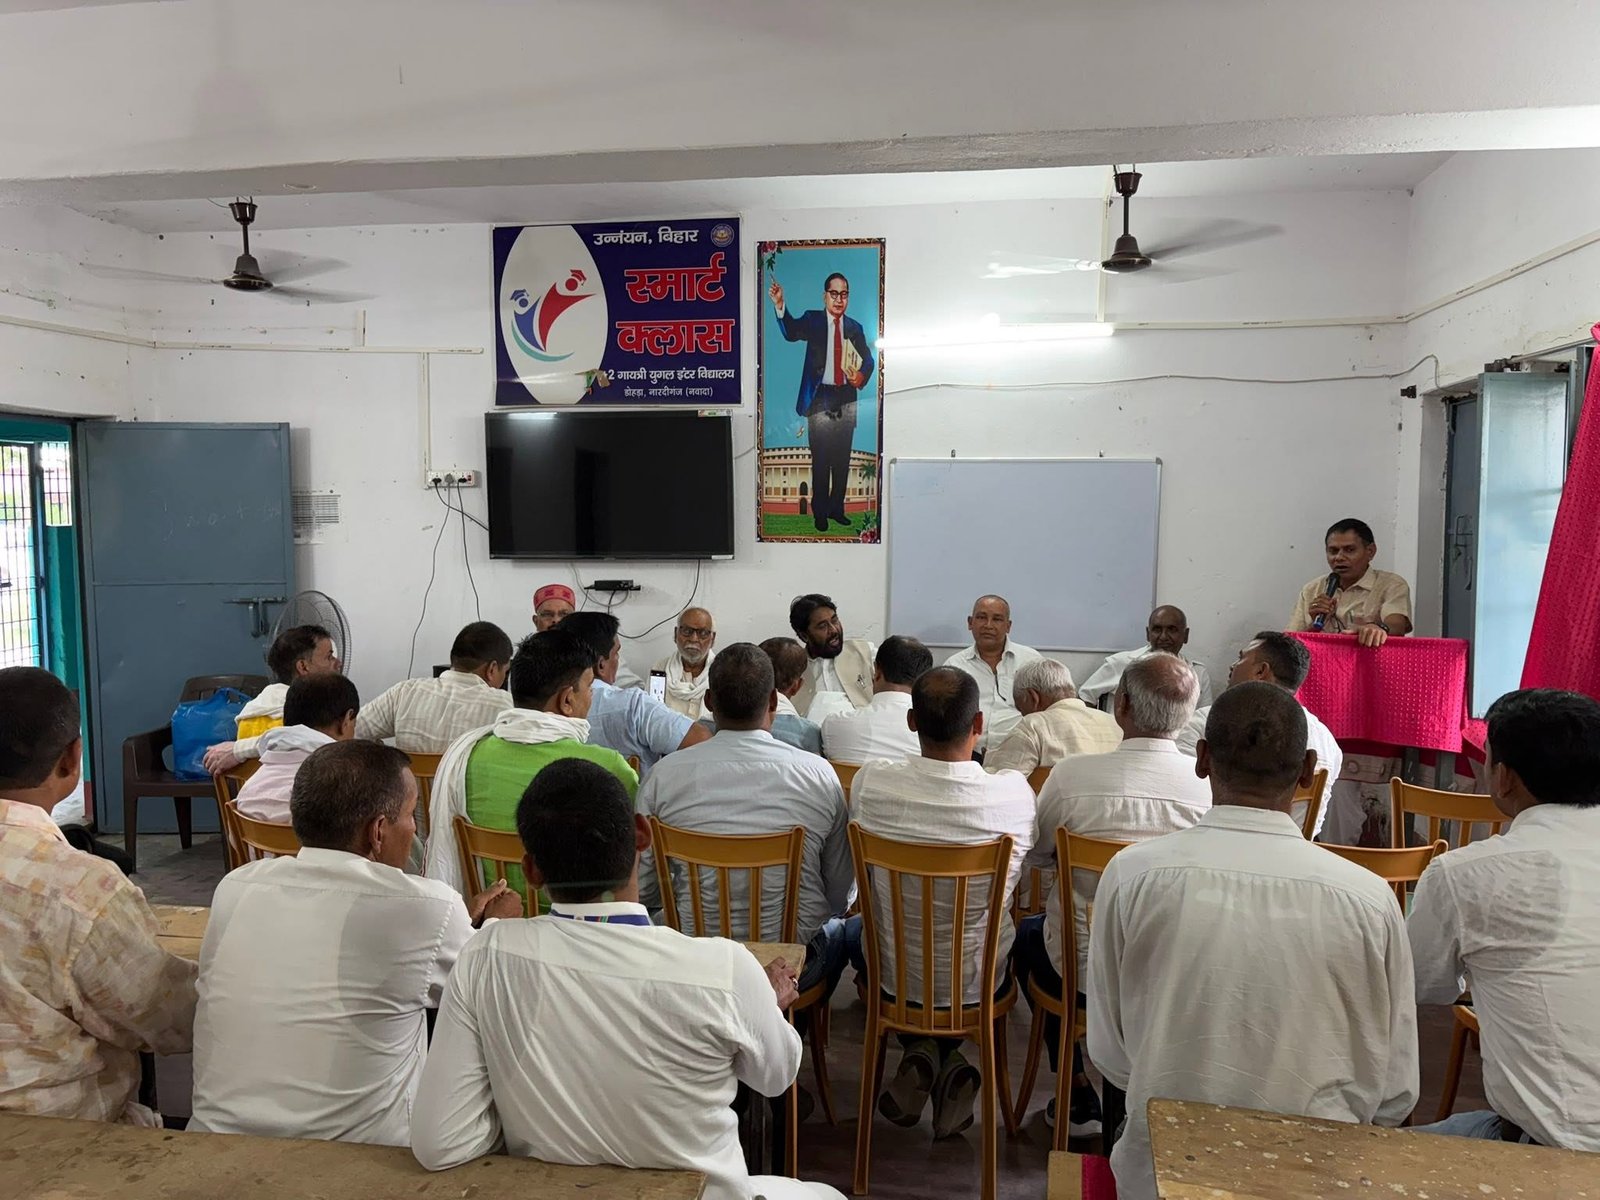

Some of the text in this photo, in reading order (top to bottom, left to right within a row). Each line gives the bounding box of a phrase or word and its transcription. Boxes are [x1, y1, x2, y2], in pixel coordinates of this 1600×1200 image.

[658, 226, 699, 244] बिहार
[624, 251, 727, 303] स्मार्ट
[616, 319, 735, 356] क्लास
[617, 367, 647, 380] गायत्री
[649, 370, 674, 384] युगल
[676, 367, 695, 381] इंटर
[698, 366, 735, 380] विद्यालय
[648, 385, 682, 397] नारदीगंज
[685, 386, 713, 397] (नवादा)
